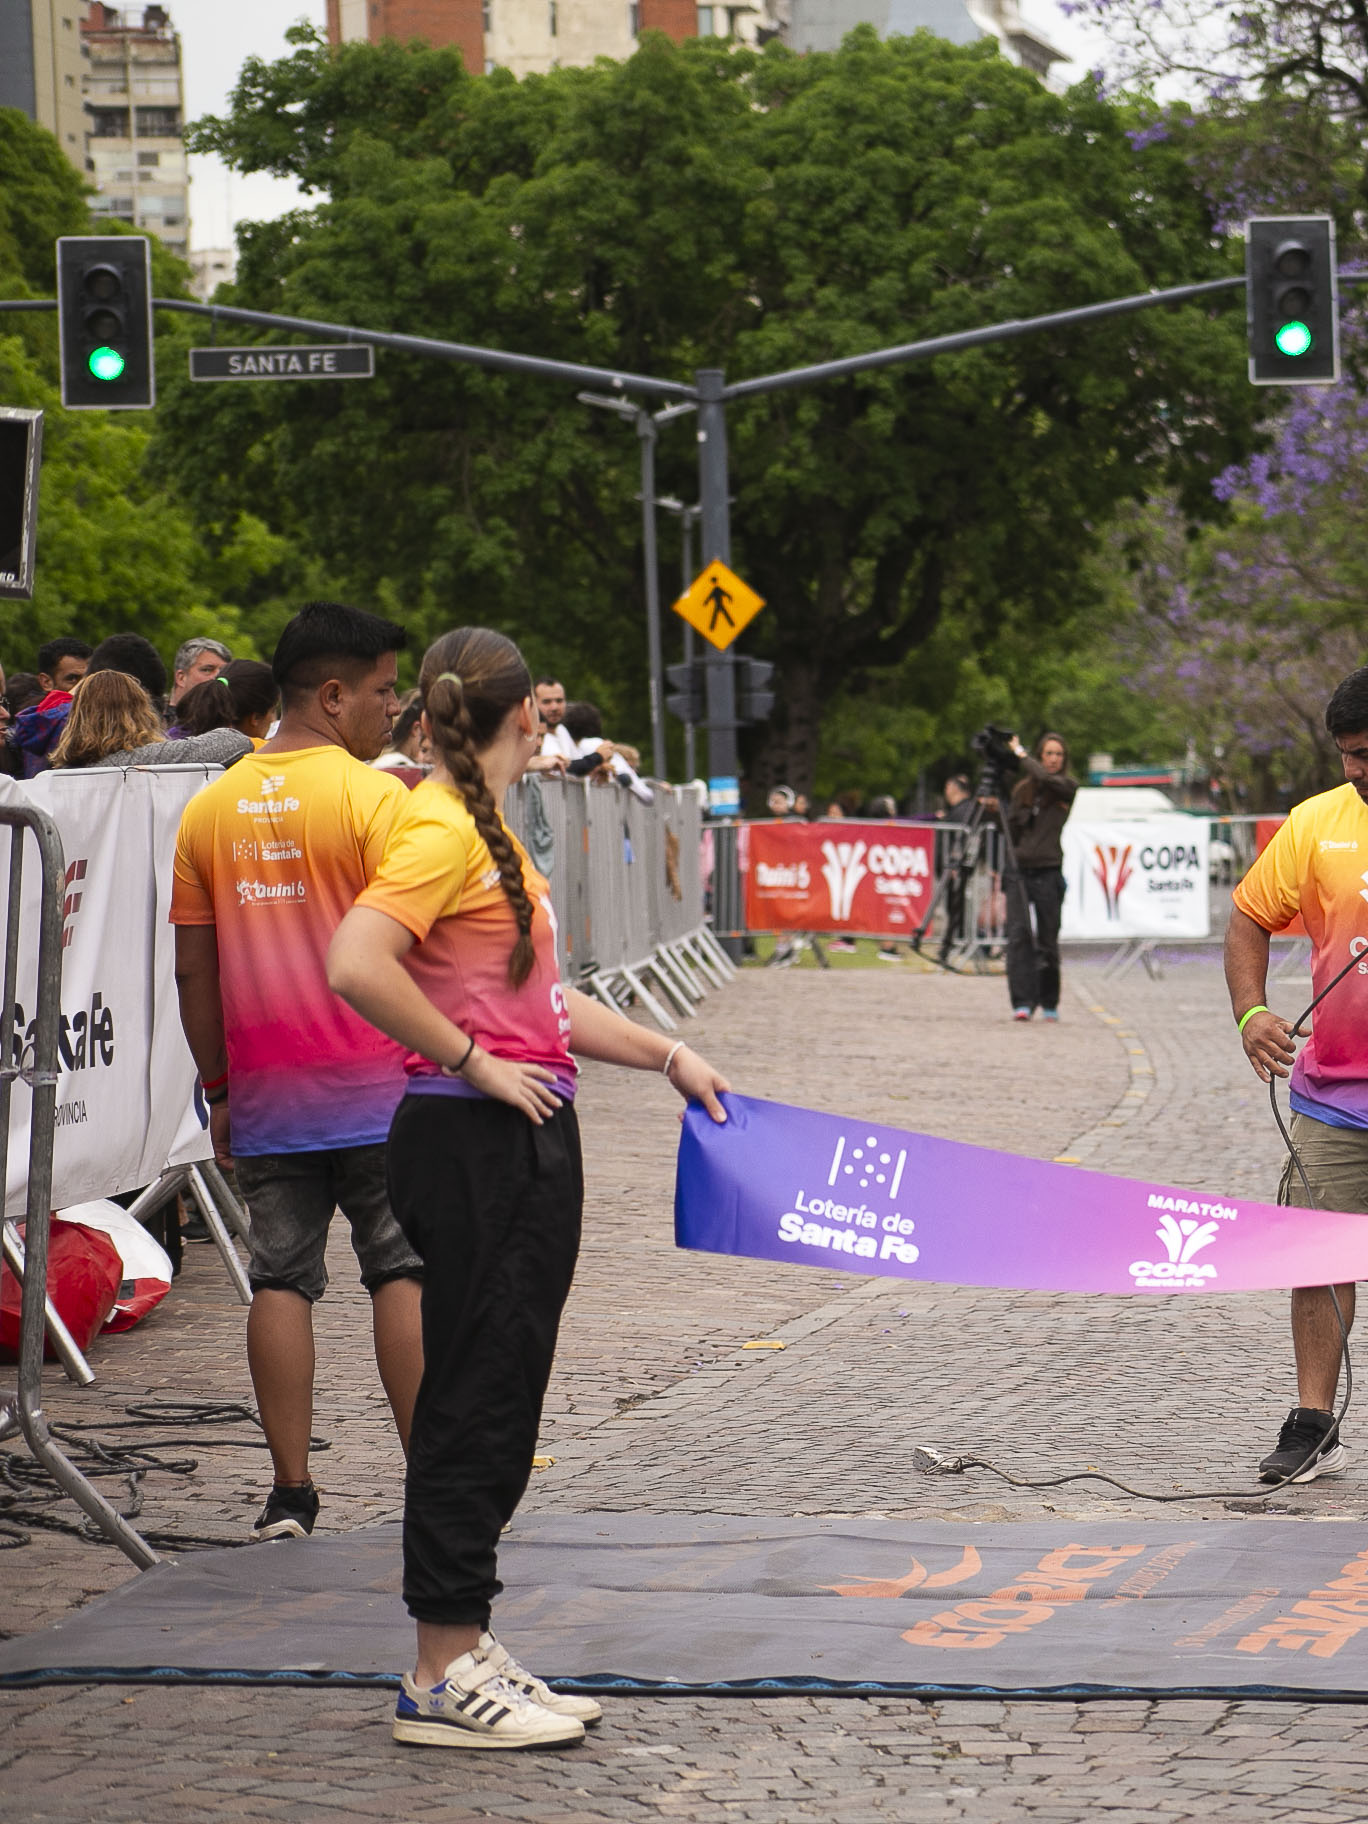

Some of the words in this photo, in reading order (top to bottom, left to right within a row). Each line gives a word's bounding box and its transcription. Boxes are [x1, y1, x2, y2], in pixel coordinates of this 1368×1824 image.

[228, 353, 303, 374] SANTA
[308, 352, 337, 372] FE
[237, 798, 282, 814] Santa
[283, 797, 300, 812] Fe
[262, 849, 291, 861] Santa
[290, 847, 302, 858] Fe
[867, 844, 930, 877] COPA
[1140, 846, 1199, 870] COPA
[255, 882, 295, 898] Quini
[297, 881, 306, 897] 6
[1148, 879, 1180, 892] Santa
[90, 992, 114, 1067] Fe
[54, 1100, 88, 1128] ROVINCIA
[795, 1190, 877, 1229] Lotería
[882, 1213, 915, 1235] de
[1147, 1194, 1238, 1220] MARATÓN
[777, 1212, 877, 1258] Santa
[879, 1235, 919, 1263] Fe
[1128, 1260, 1217, 1278] COPA
